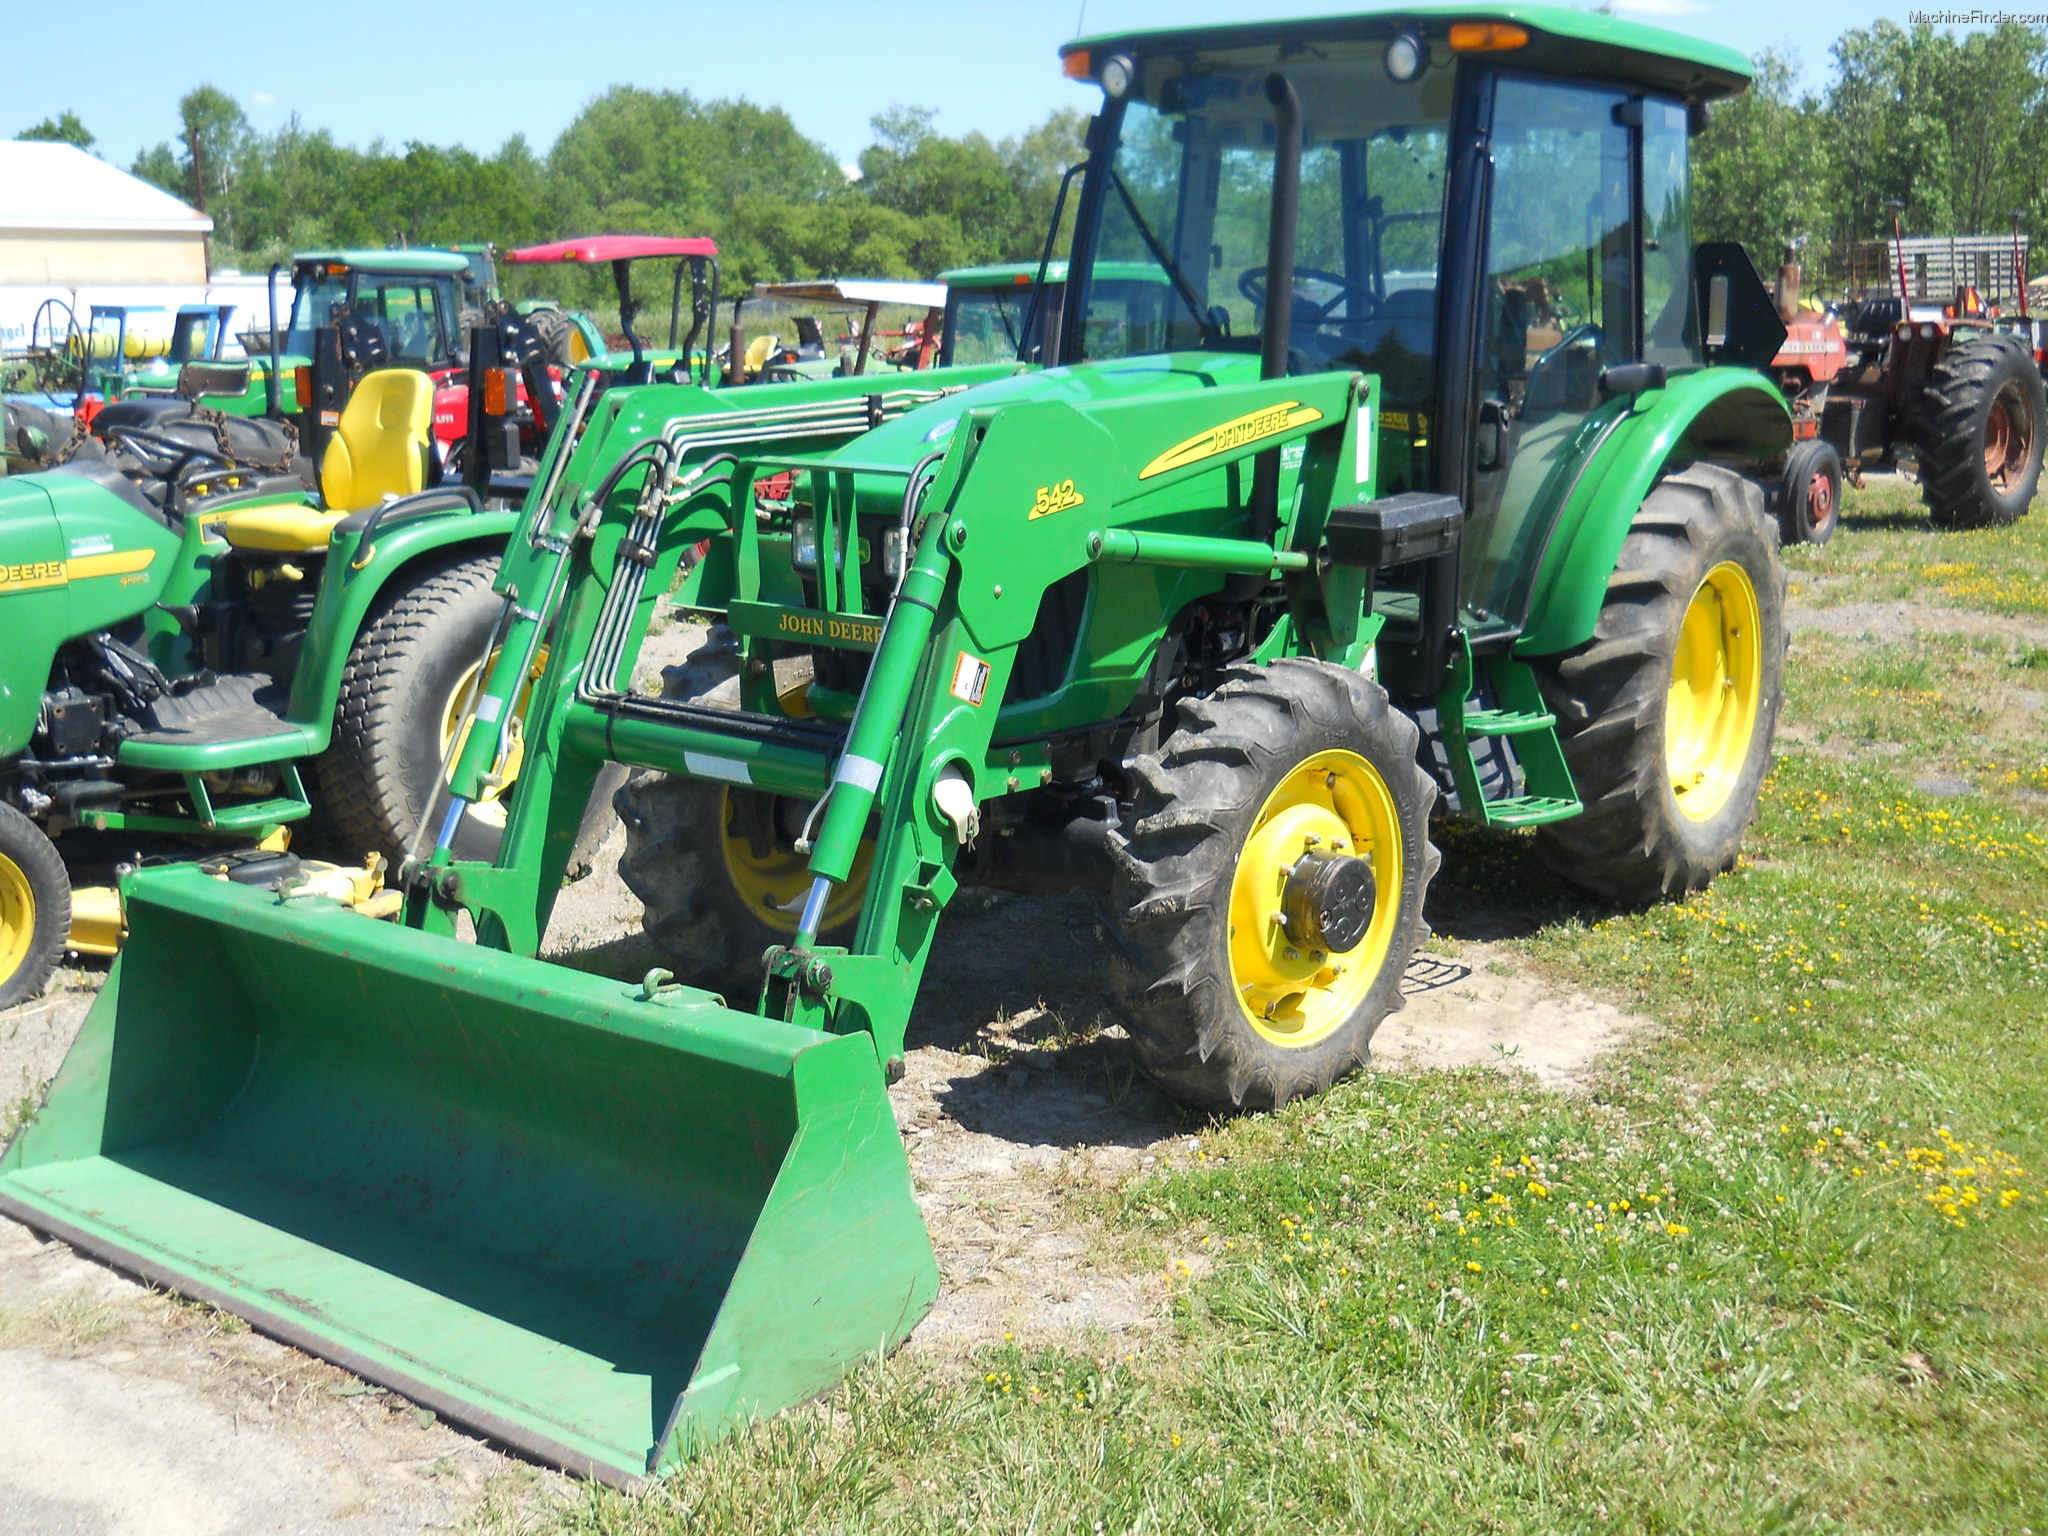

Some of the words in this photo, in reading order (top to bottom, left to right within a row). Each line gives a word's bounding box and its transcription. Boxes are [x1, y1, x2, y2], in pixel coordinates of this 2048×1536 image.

[1211, 422, 1246, 452] JOHN
[1246, 409, 1289, 440] DEERE
[1036, 479, 1076, 514] 542
[0, 560, 61, 583] DEERE
[779, 614, 824, 636] JOHN
